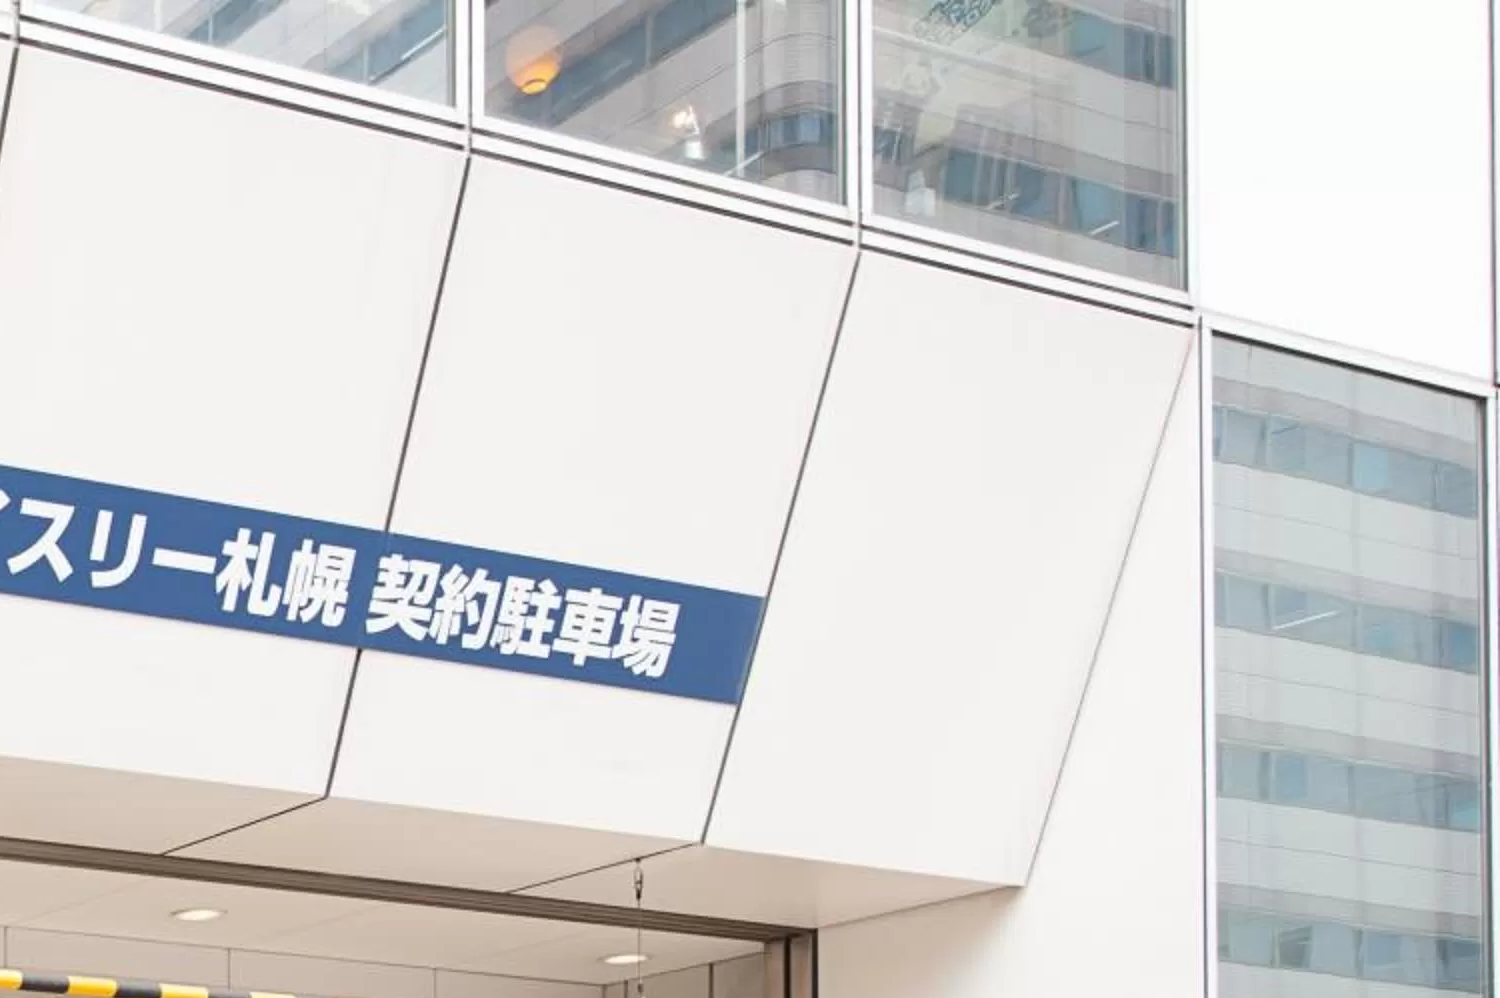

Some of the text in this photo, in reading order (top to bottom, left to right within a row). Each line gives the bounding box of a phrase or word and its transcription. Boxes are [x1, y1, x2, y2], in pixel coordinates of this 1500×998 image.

[365, 553, 681, 679] 契約駐車場
